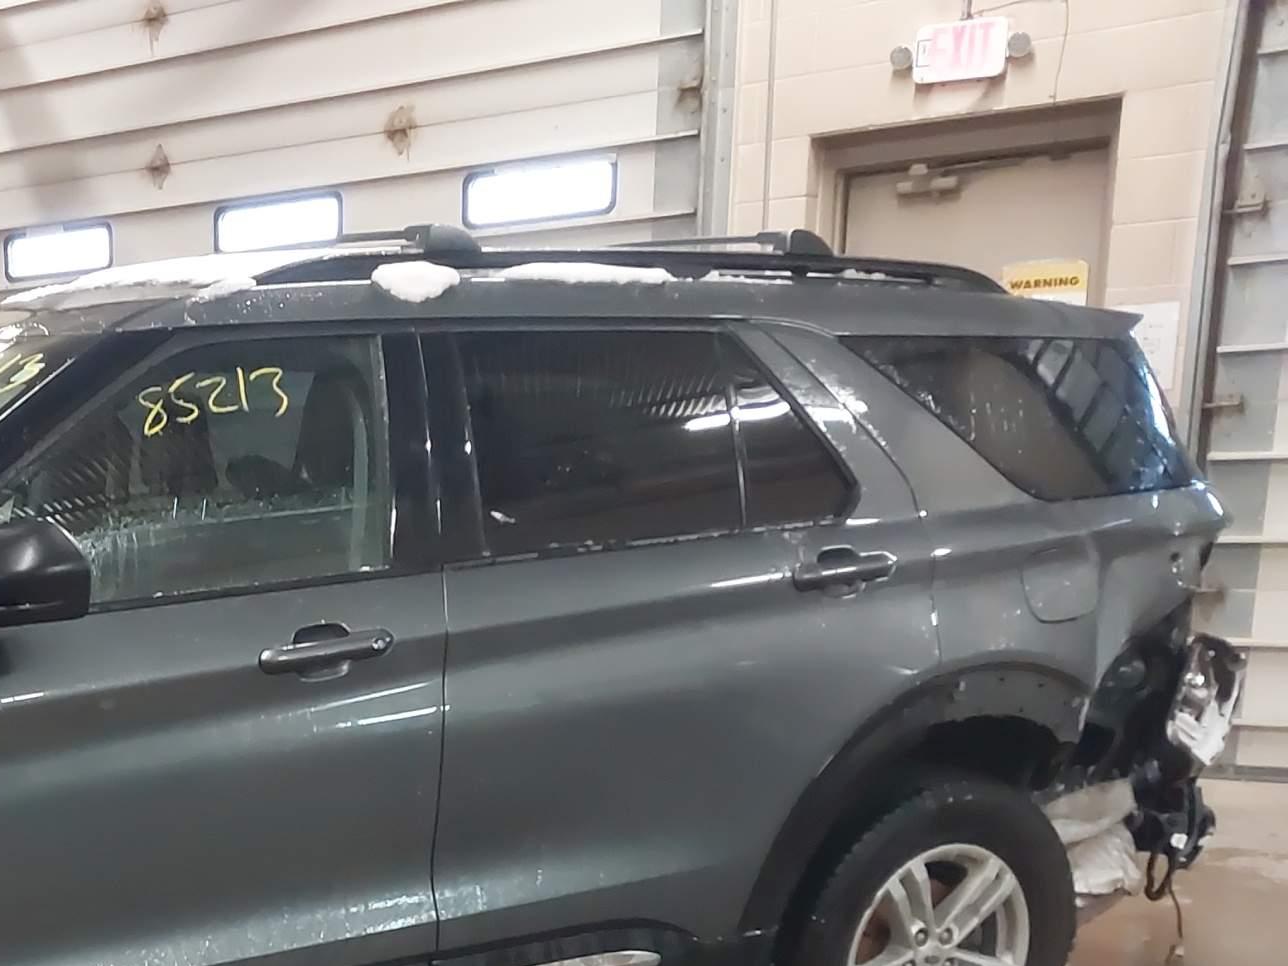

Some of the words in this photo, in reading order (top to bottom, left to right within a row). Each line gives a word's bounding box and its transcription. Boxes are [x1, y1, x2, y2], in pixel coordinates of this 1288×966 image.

[928, 21, 996, 67] EXIT
[1009, 276, 1080, 290] WARNING
[137, 366, 289, 437] 85213
